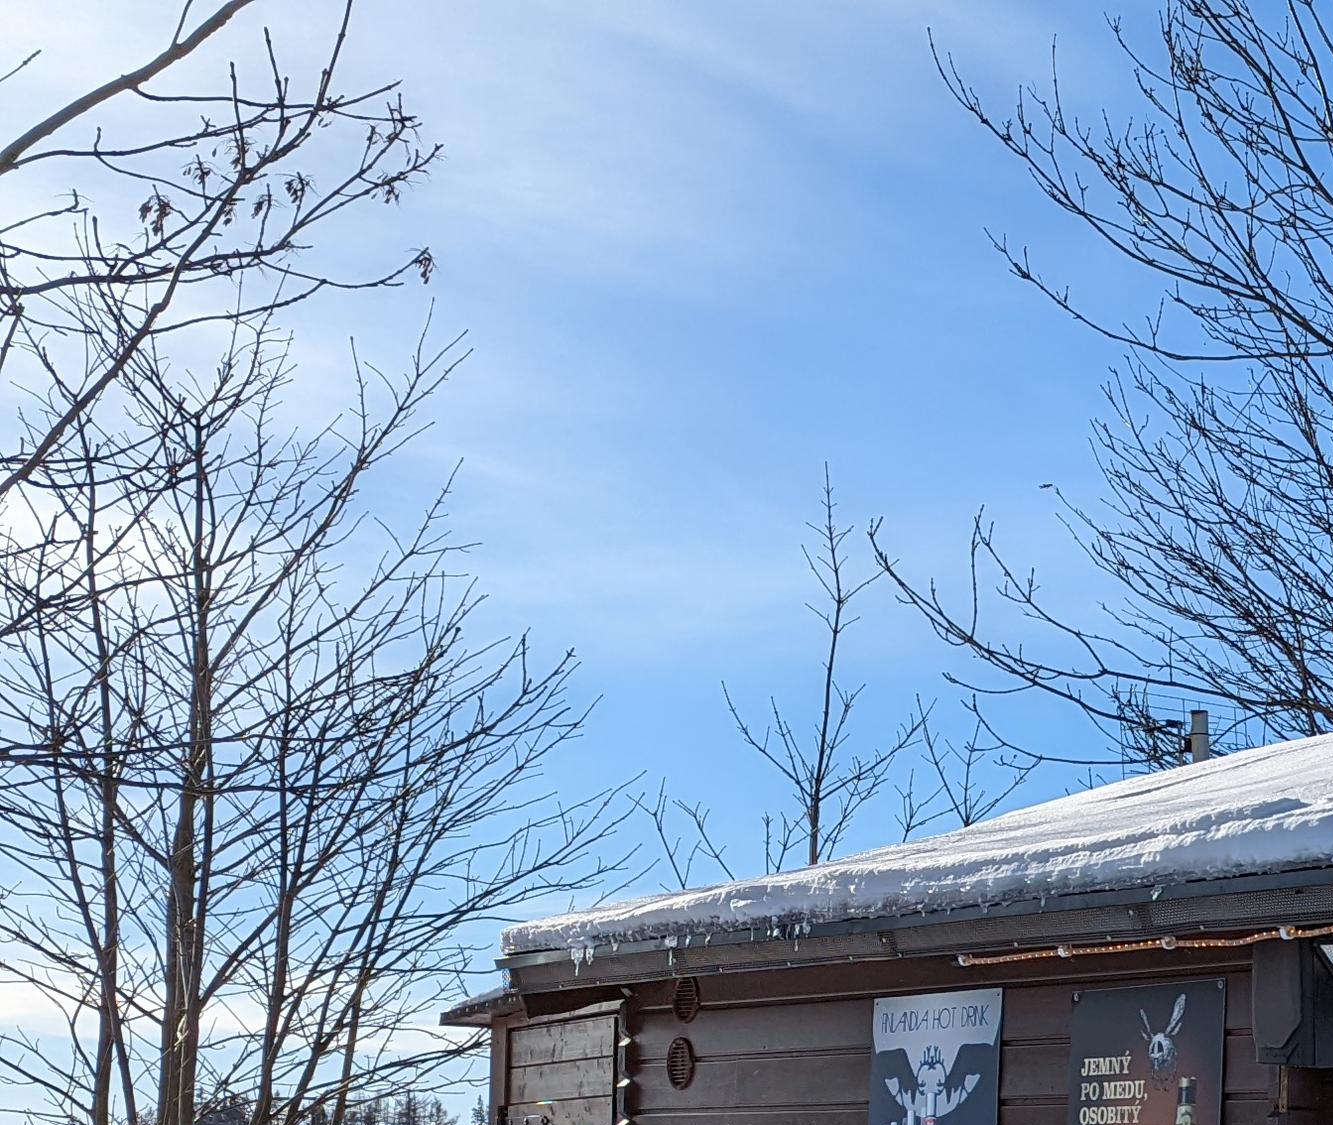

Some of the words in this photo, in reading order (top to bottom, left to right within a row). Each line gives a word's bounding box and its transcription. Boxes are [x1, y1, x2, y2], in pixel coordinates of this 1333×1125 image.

[932, 1007, 957, 1029] HOT
[960, 1004, 990, 1028] DRINK
[1081, 1050, 1132, 1077] JEMNÝ
[1080, 1082, 1100, 1101] PO
[1102, 1080, 1148, 1101] MEDU,
[1079, 1100, 1141, 1125] OSOBITÝ
